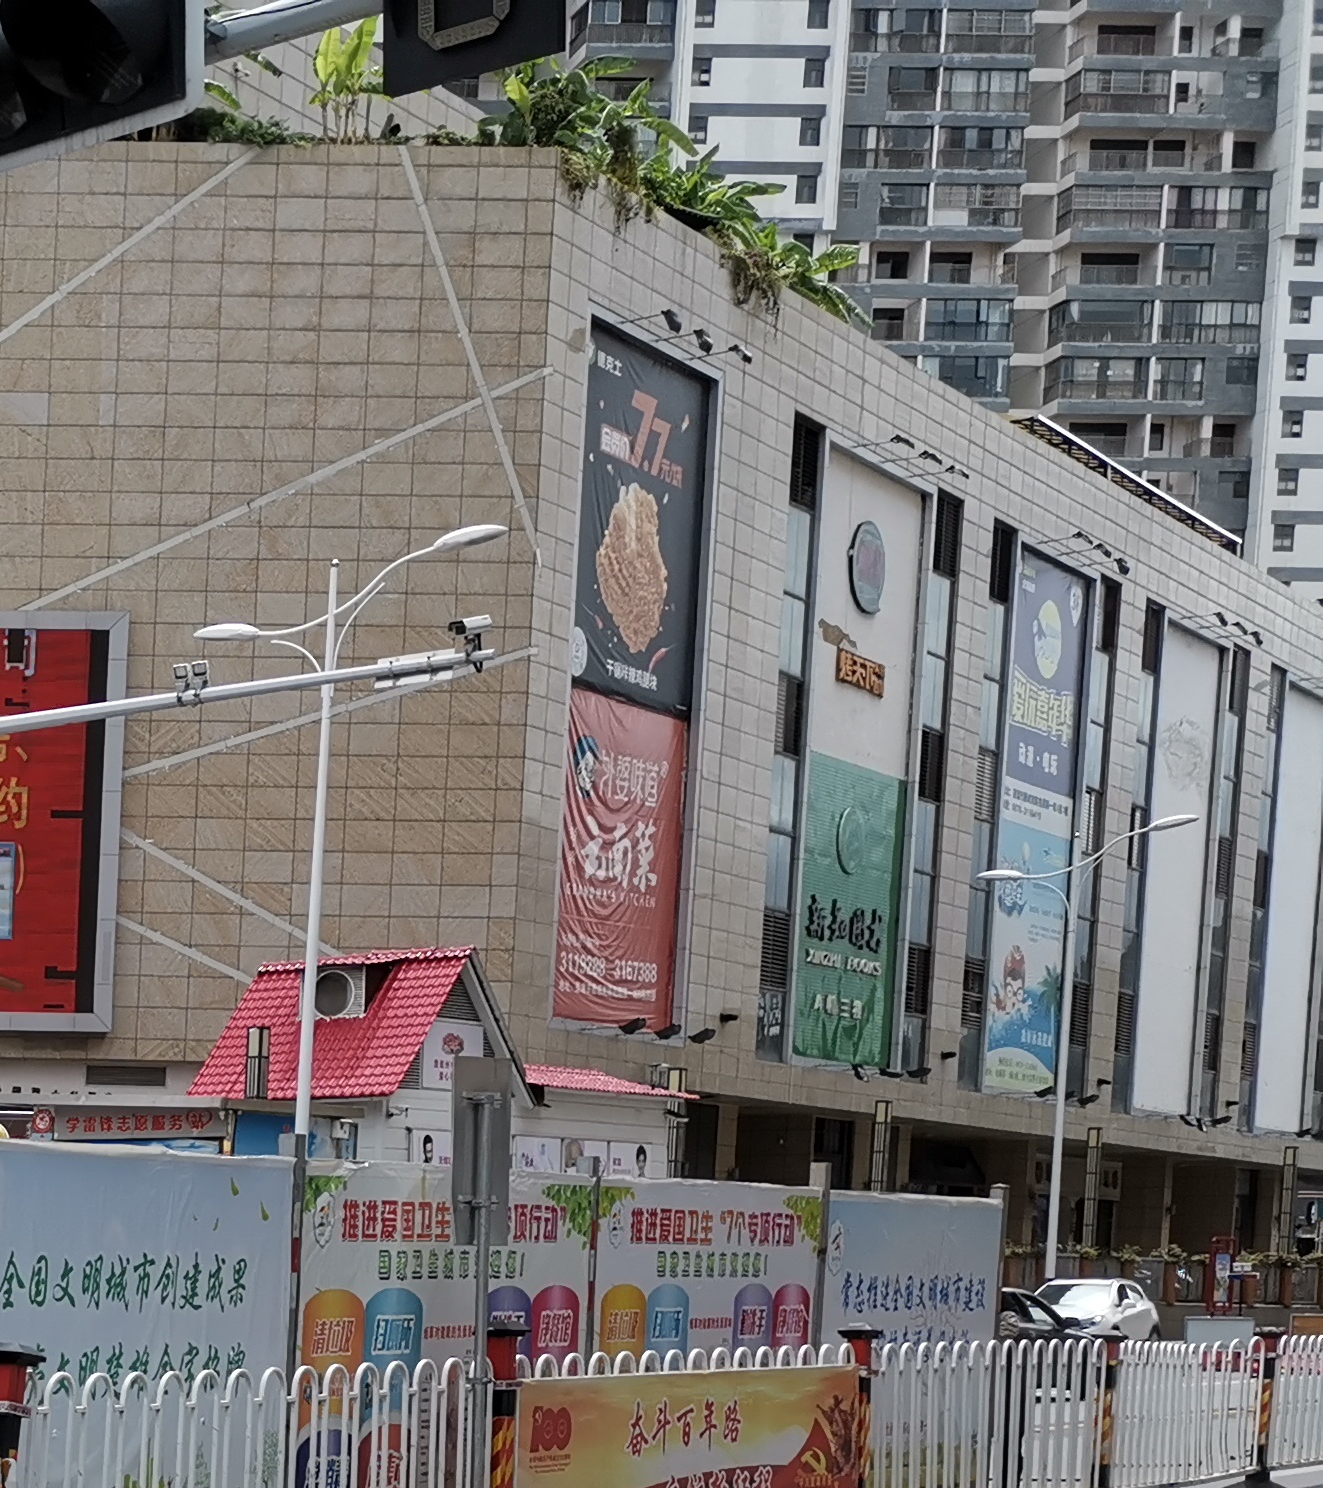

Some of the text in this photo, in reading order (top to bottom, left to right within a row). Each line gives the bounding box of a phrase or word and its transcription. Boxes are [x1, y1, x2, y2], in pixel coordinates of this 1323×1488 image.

[66, 1110, 210, 1134] 学雷锋志愿服务站
[342, 1199, 452, 1242] 推进爱国卫生
[630, 1207, 713, 1245] 推进爱国卫生
[377, 1249, 526, 1282] 国家卫生城市迎您!
[311, 1317, 355, 1356] 清垃圾
[624, 1397, 743, 1458] 奋斗百年路
